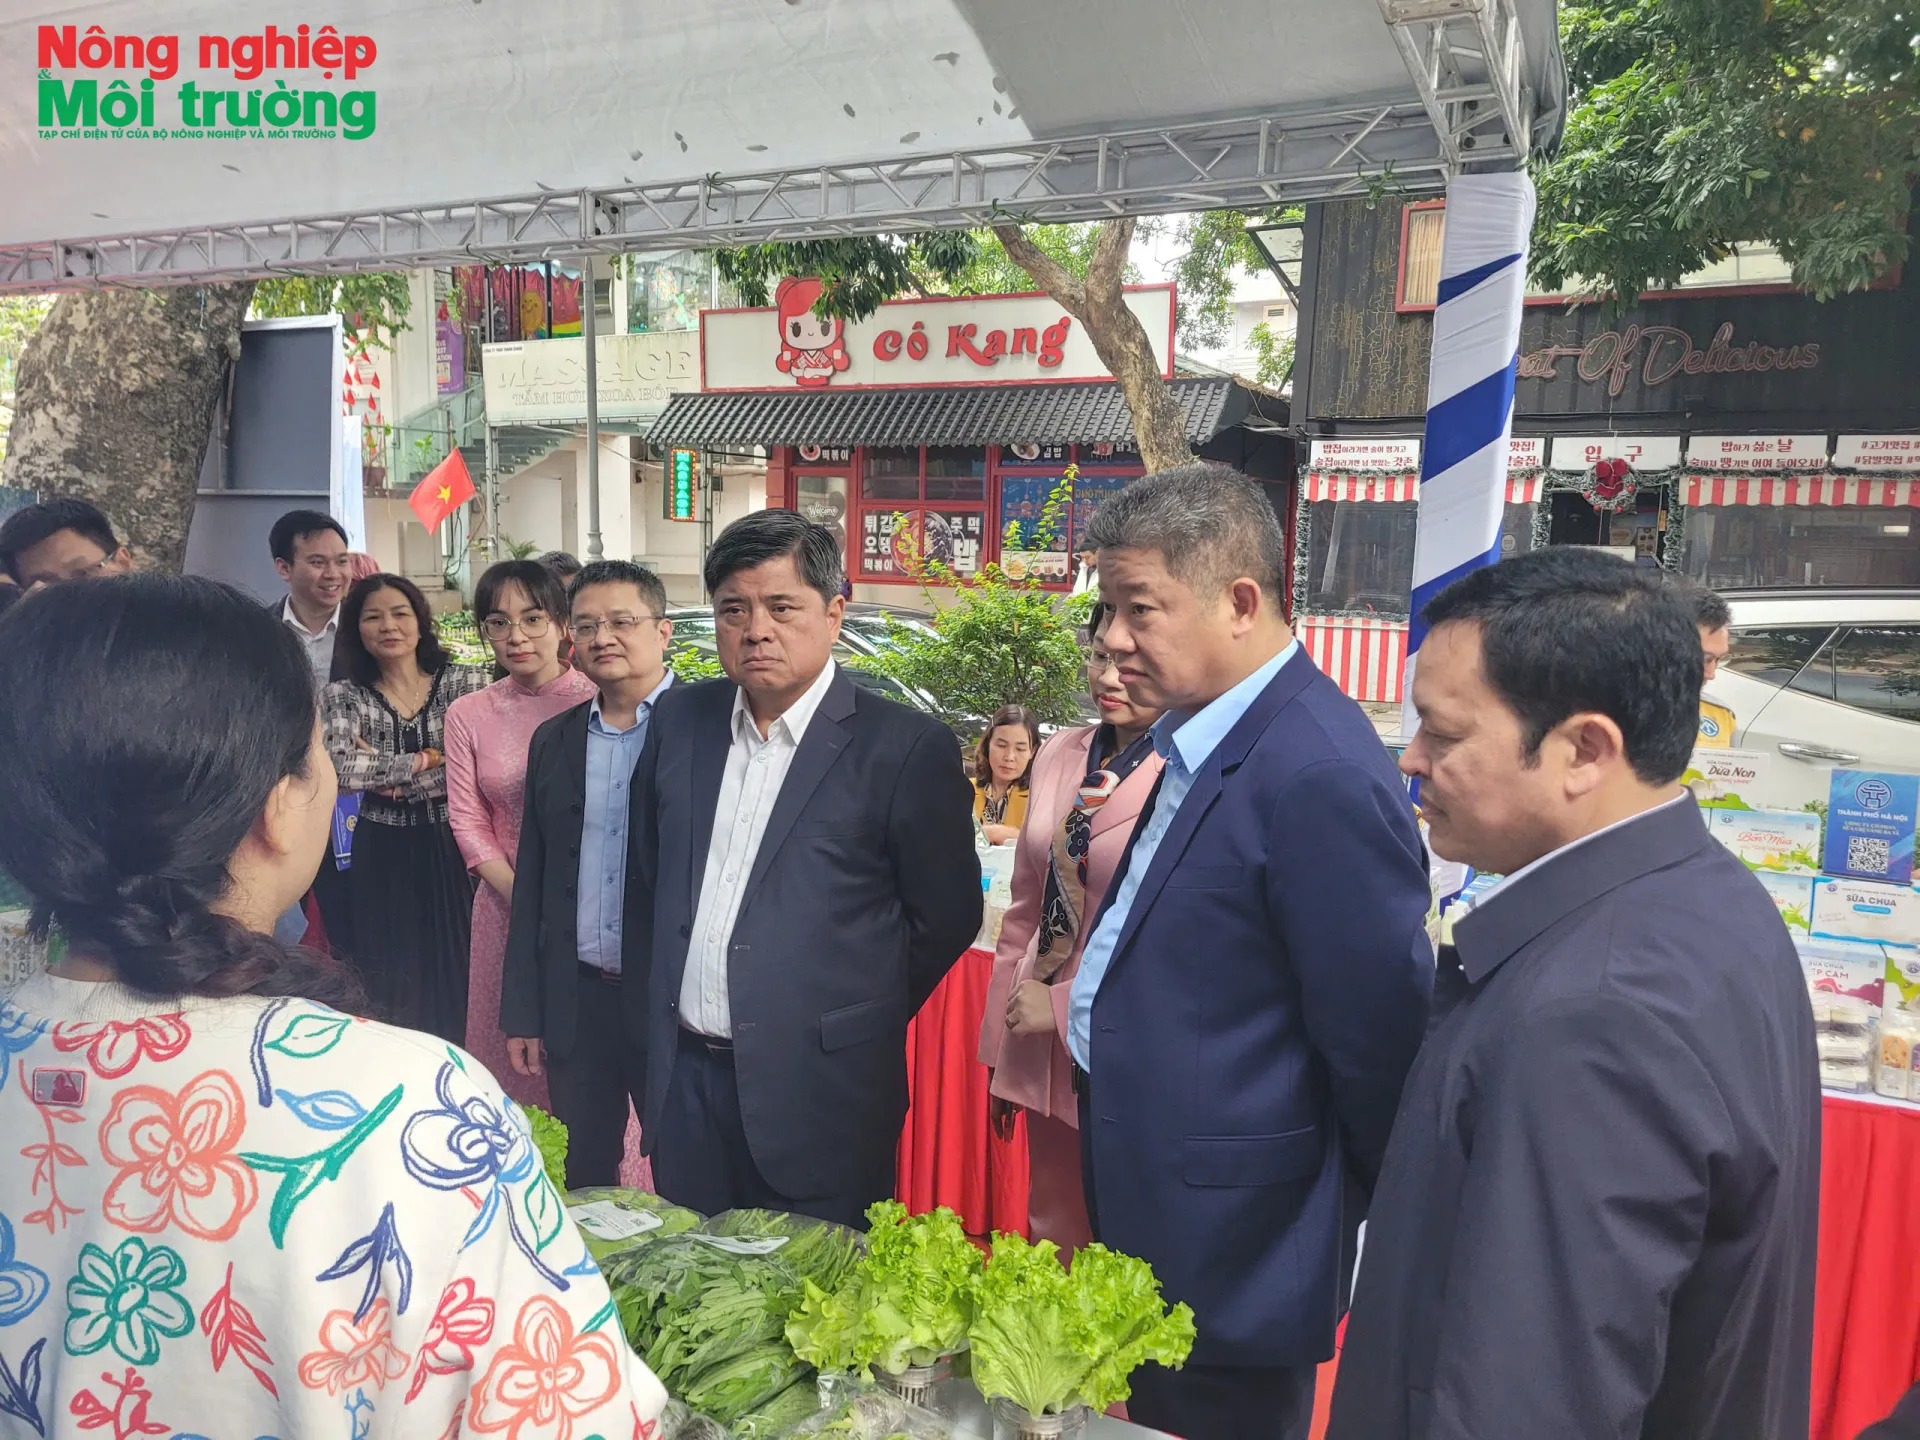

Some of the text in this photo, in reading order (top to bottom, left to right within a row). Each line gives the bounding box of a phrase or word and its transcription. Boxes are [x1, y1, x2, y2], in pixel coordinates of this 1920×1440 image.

[945, 316, 1072, 368] Kang
[1577, 324, 1640, 396] Of
[1640, 321, 1820, 386] Delicious
[598, 388, 636, 403] XOA
[1777, 438, 1794, 453] 날
[953, 538, 980, 571] 밥
[1731, 767, 1756, 778] Non
[1846, 893, 1897, 907] SỮA CHUA
